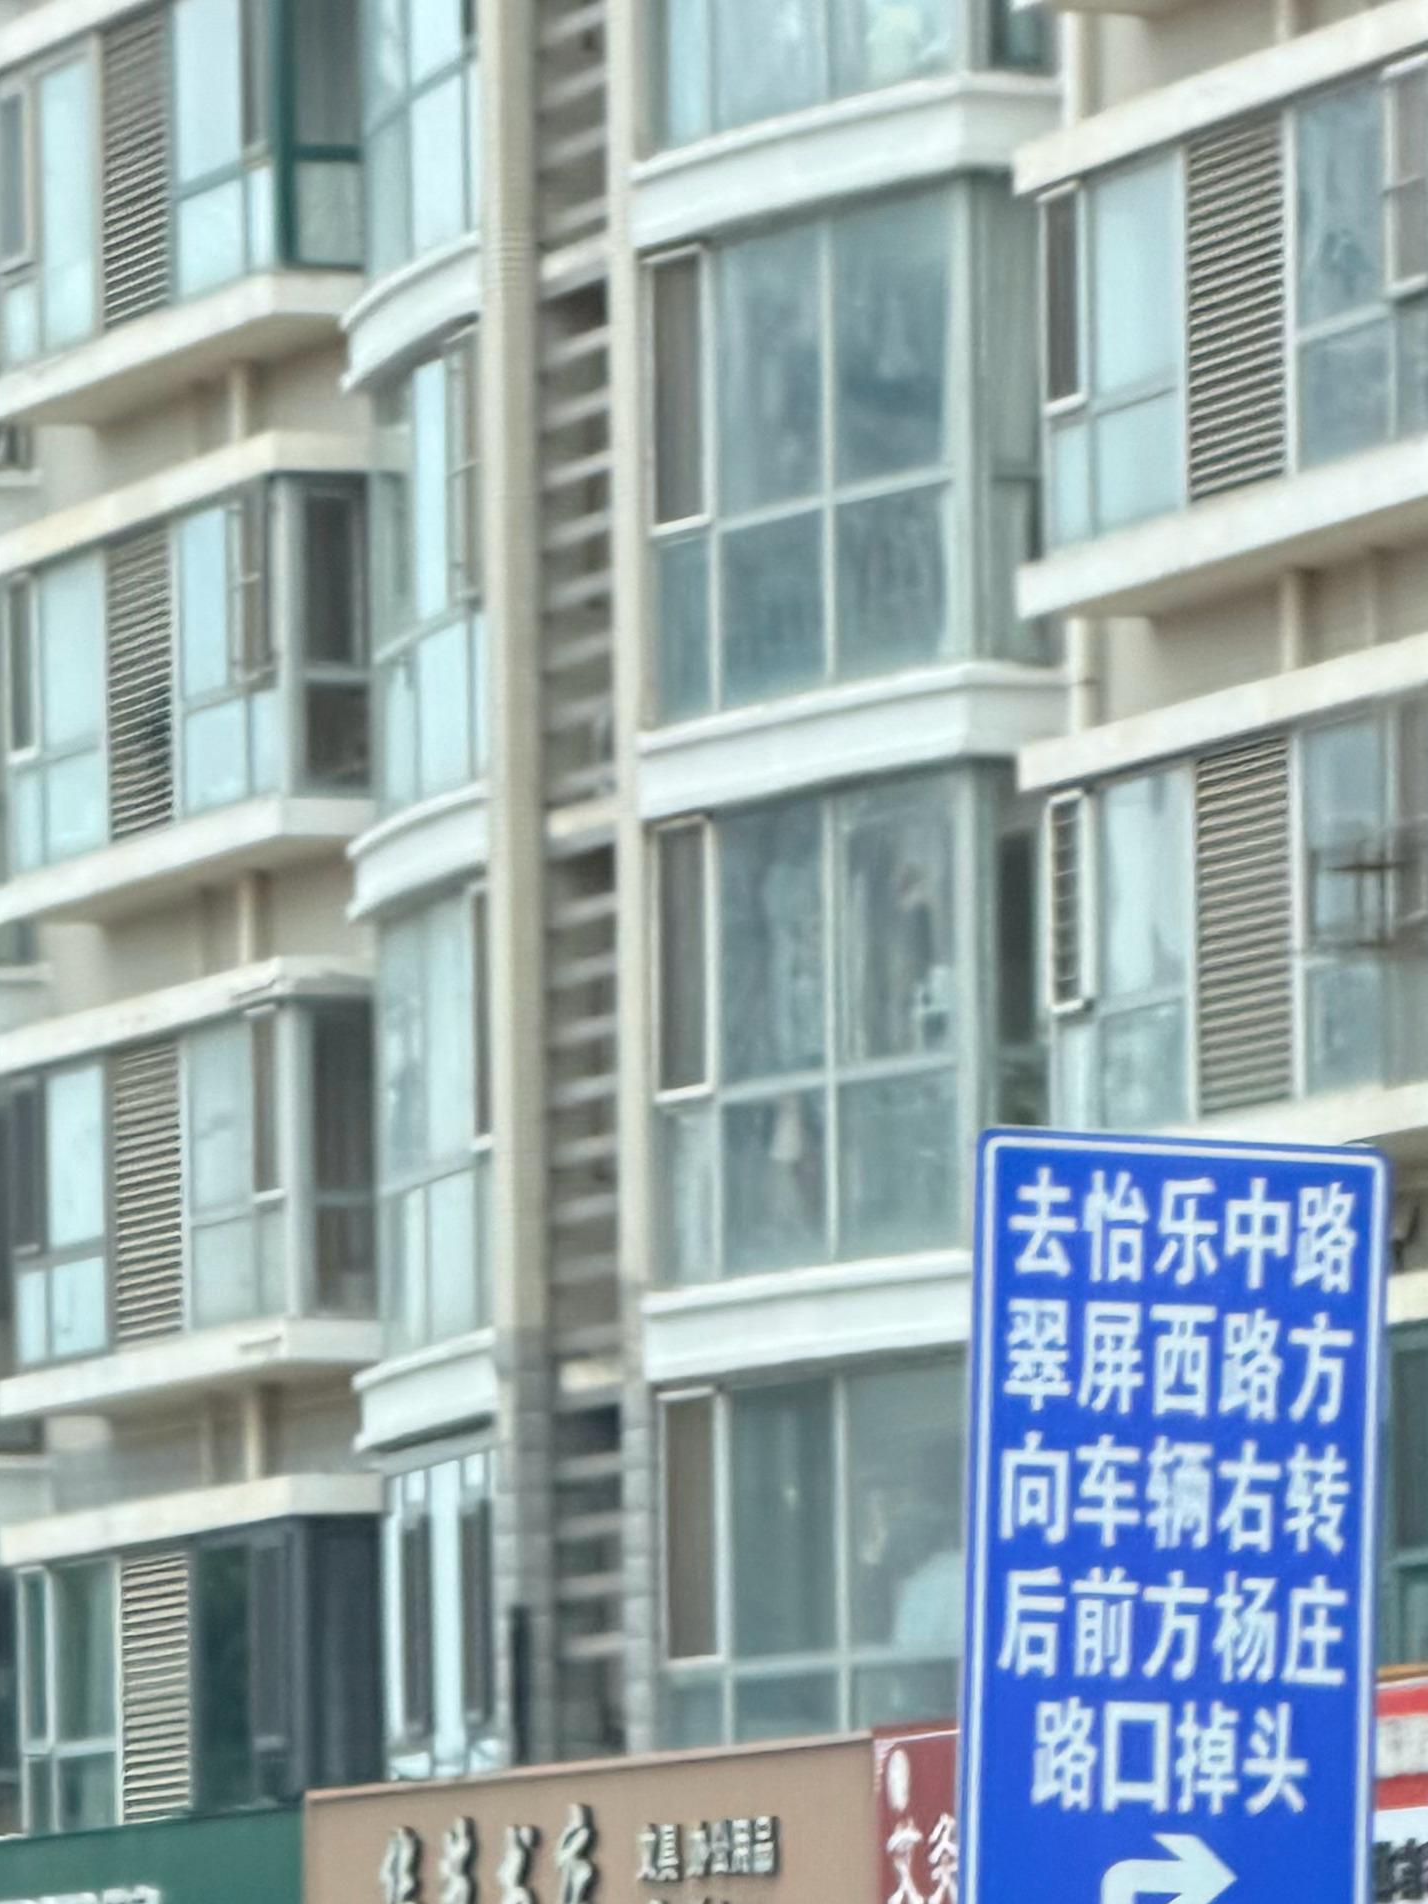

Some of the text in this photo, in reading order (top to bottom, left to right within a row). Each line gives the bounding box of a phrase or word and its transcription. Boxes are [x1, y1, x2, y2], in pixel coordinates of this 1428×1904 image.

[1007, 1166, 1358, 1294] 去怡乐中路
[1003, 1297, 1355, 1424] 翠屏西路方
[998, 1430, 1350, 1555] 向车辆右转
[997, 1565, 1348, 1686] 后前方杨庄
[1029, 1696, 1309, 1816] 路口掉头
